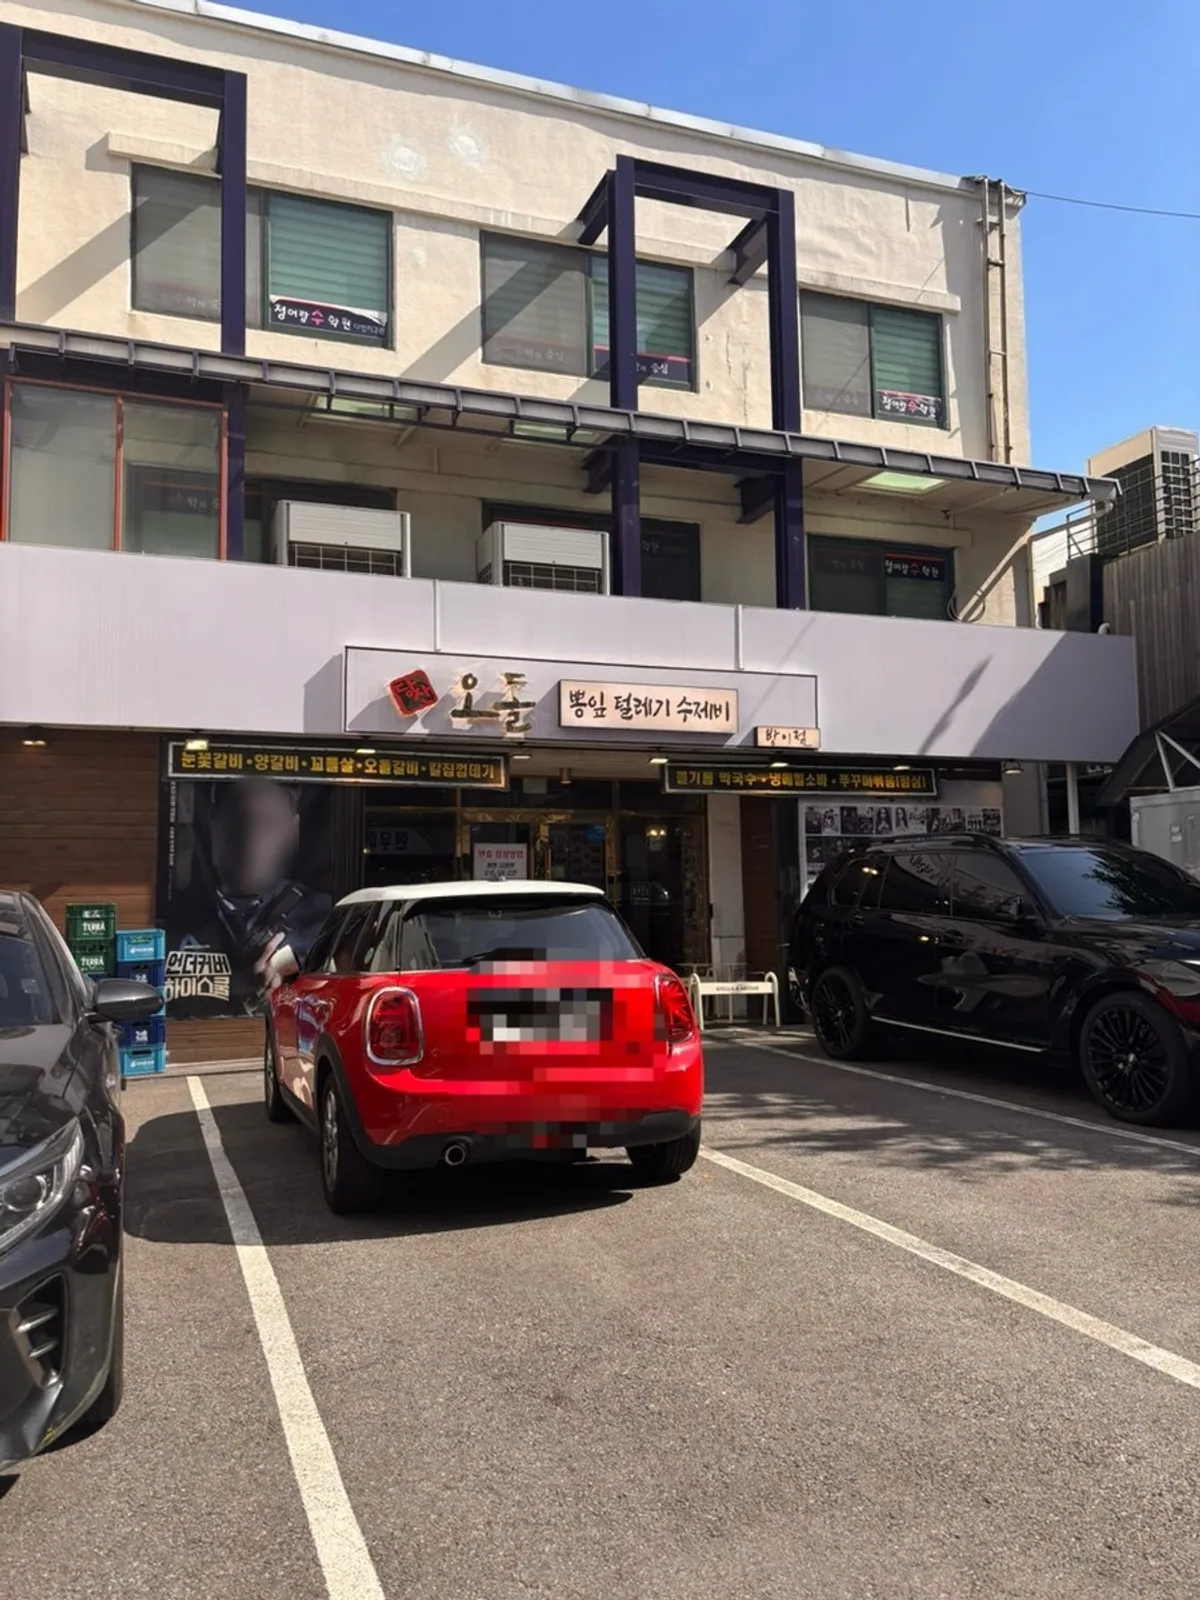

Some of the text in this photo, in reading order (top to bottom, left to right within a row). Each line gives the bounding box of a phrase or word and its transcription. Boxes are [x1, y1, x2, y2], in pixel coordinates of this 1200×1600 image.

[450, 672, 536, 732] 오돌
[569, 688, 730, 722] 뽕잎 털레기 수제비
[765, 727, 811, 747] 방이점
[254, 753, 298, 771] 양갈비
[82, 921, 106, 931] TERRA
[81, 955, 105, 967] TERRA
[166, 952, 230, 975] 언더커버
